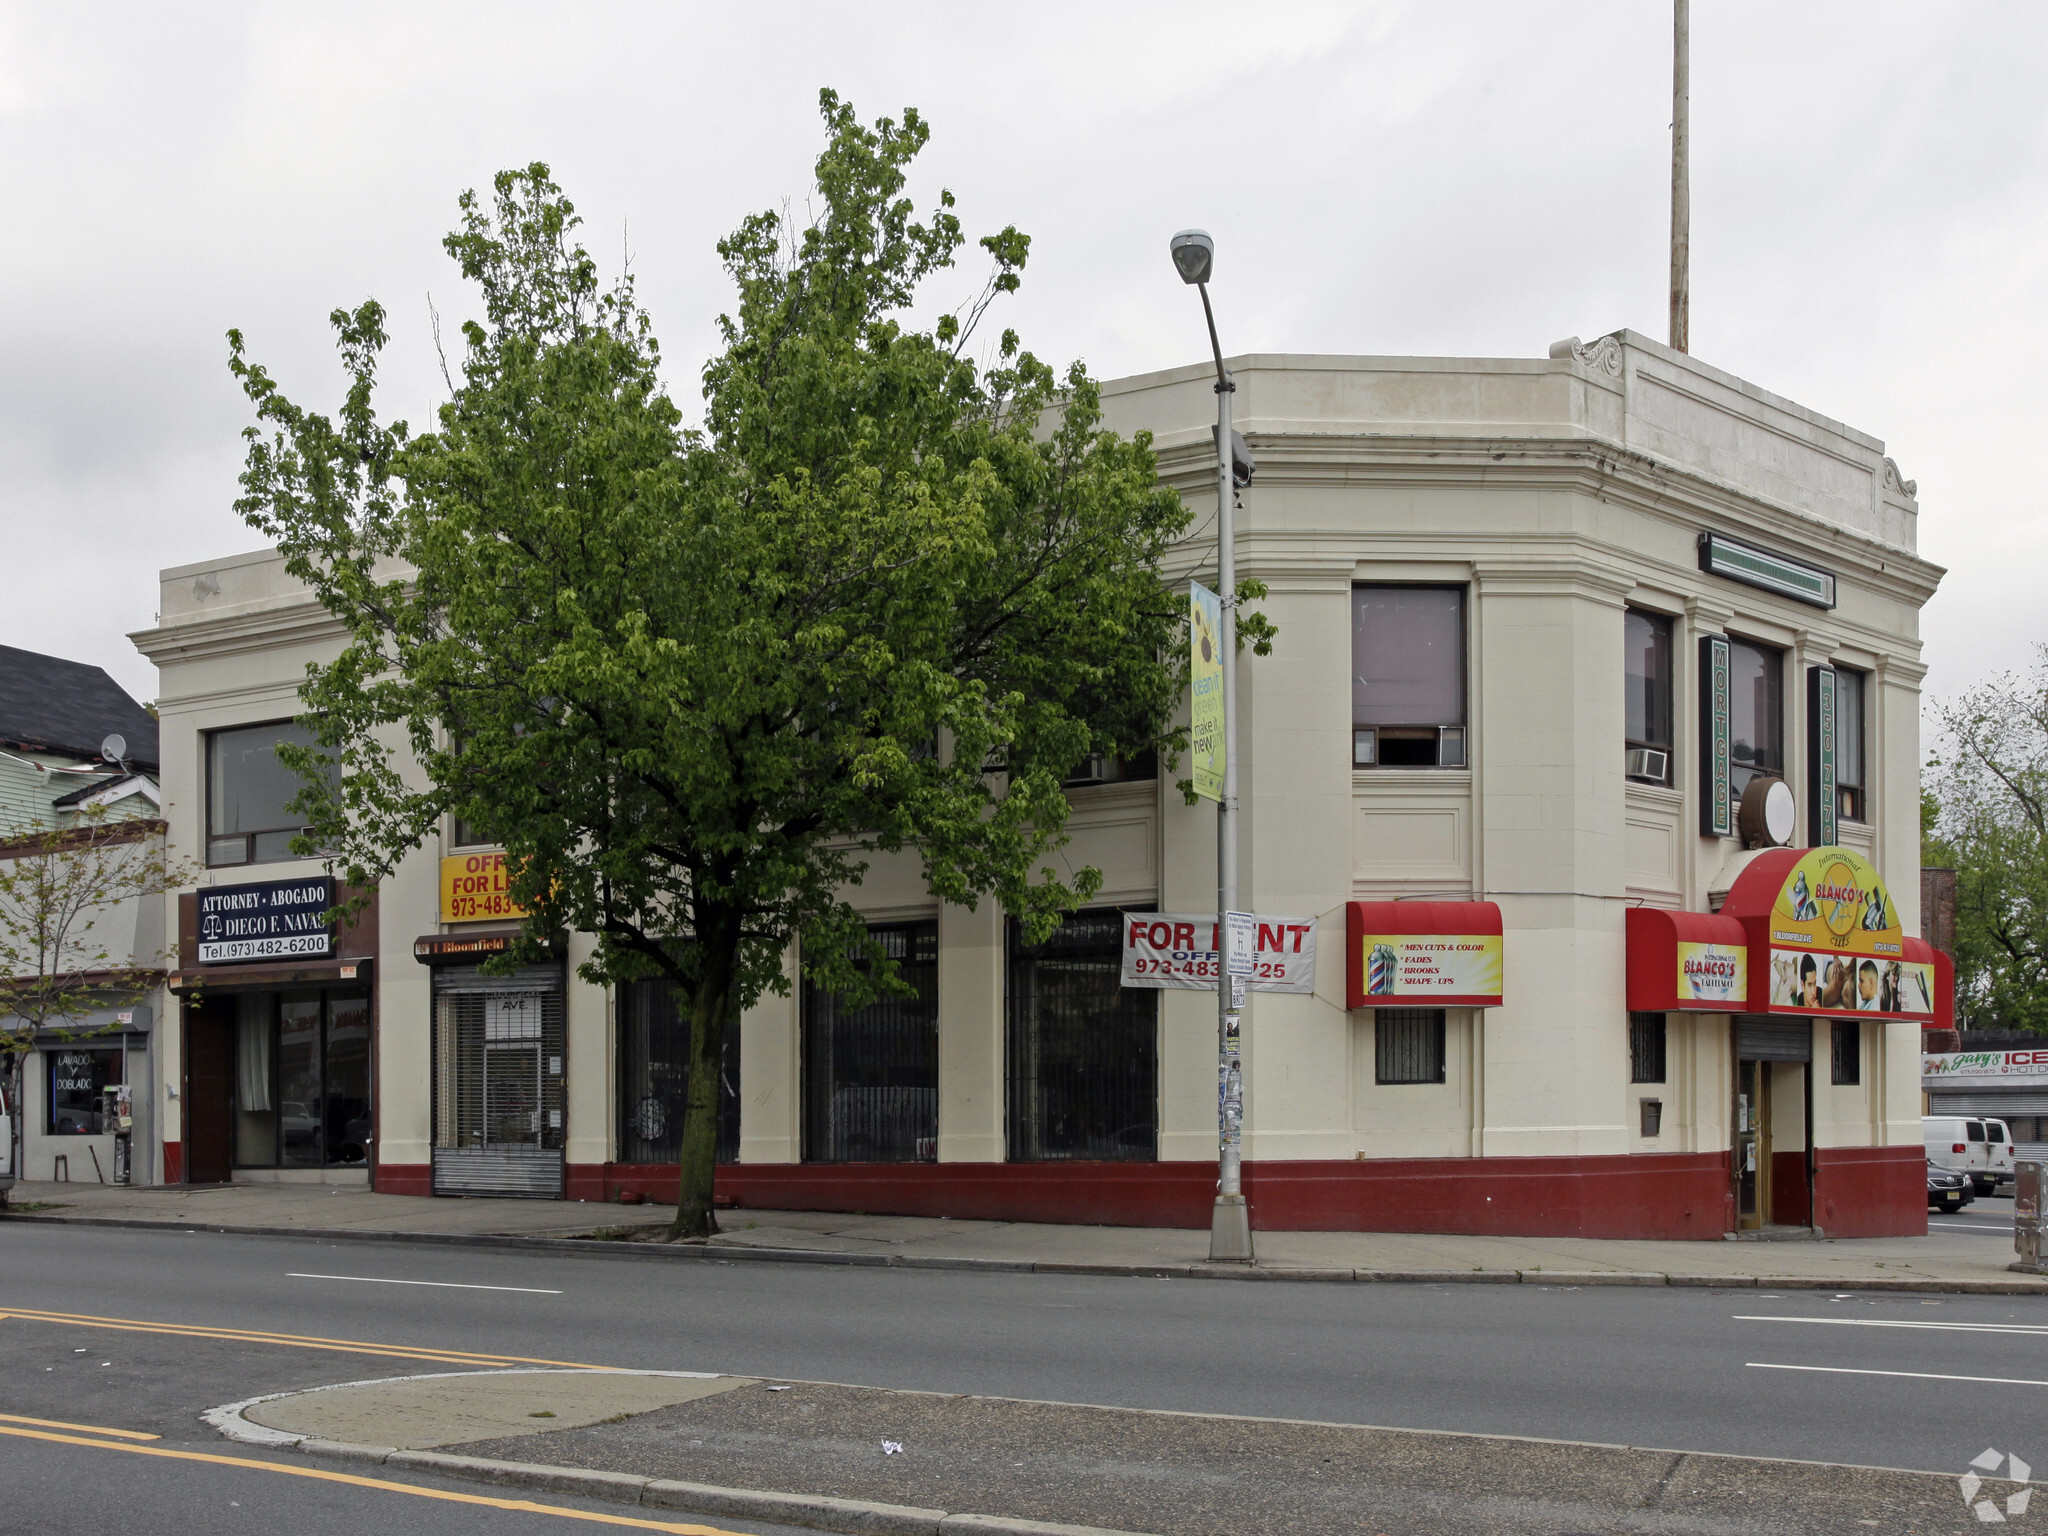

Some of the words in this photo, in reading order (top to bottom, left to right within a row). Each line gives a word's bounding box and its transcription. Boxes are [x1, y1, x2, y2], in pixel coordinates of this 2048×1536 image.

[1193, 674, 1212, 696] clean
[1213, 672, 1219, 690] it
[1195, 718, 1213, 737] make
[1213, 717, 1218, 730] it
[1715, 647, 1726, 826] MORTGAGE
[1818, 853, 1862, 874] International
[453, 875, 488, 895] FOR
[1815, 883, 1864, 905] BLANCO'S
[202, 893, 260, 912] ATTORNEY
[271, 886, 325, 906] ABOGADO
[452, 895, 530, 917] 973-483-
[226, 917, 266, 936] DIEGO
[271, 916, 280, 933] F.
[284, 911, 326, 932] NAVAS
[257, 937, 325, 955] 482-6200
[442, 939, 504, 953] Bloomfield
[1130, 922, 1195, 950] FOR
[1212, 922, 1310, 953] NT
[1830, 936, 1850, 948] cuts
[1172, 952, 1259, 963] OFF
[1684, 960, 1735, 977] BLANCO'S
[58, 1055, 90, 1066] LAVADO
[2005, 1052, 2048, 1065] ICE
[70, 1067, 78, 1077] Y
[2010, 1065, 2036, 1074] HOT
[56, 1079, 92, 1090] DOBLADO
